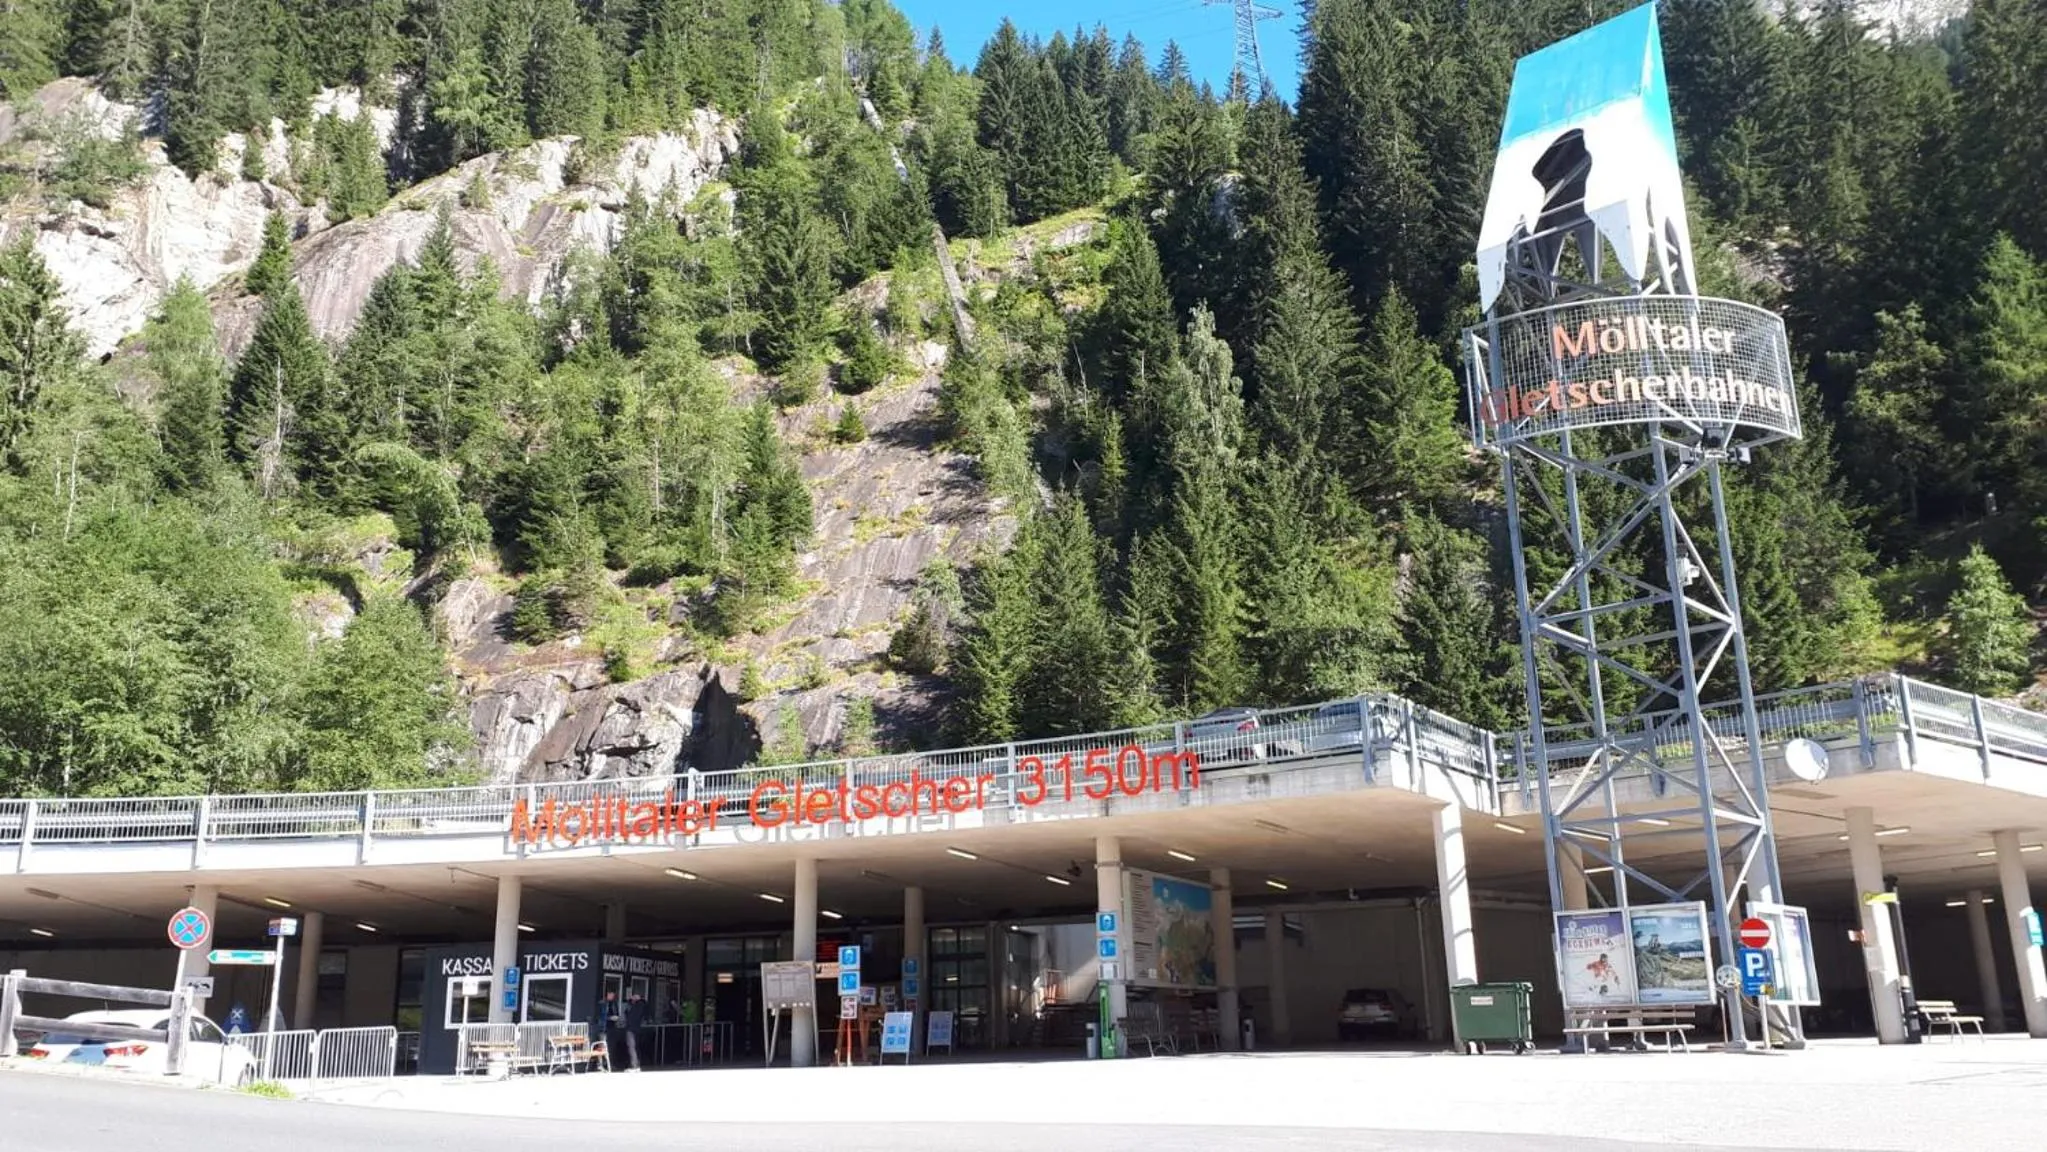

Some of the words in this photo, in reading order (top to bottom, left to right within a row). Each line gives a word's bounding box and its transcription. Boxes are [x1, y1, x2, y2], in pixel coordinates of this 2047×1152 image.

[1552, 314, 1736, 360] Mölltaler
[1480, 366, 1793, 426] Gletscherbahnen
[748, 770, 994, 829] Gletscher
[1017, 744, 1199, 807] 3150m
[441, 957, 494, 976] KASSA
[523, 952, 589, 971] TICKETS
[1745, 952, 1764, 977] P
